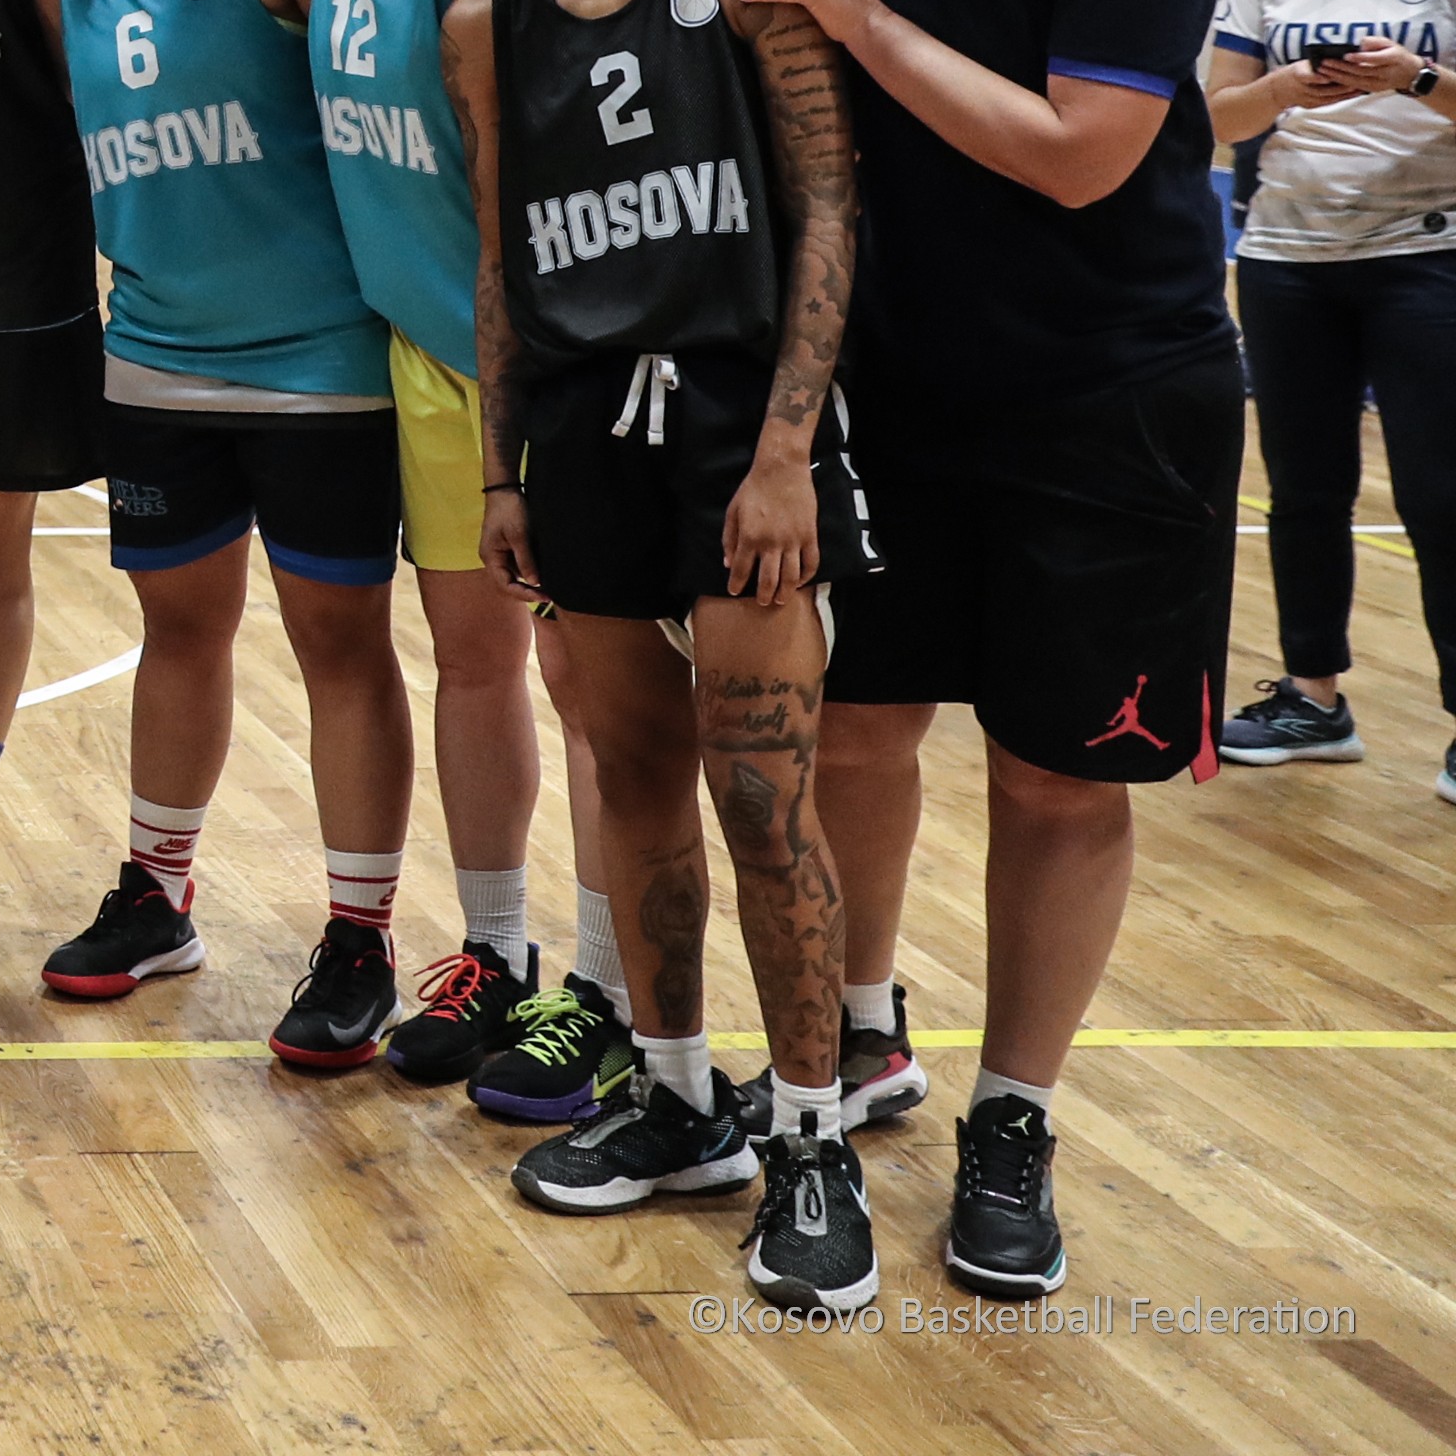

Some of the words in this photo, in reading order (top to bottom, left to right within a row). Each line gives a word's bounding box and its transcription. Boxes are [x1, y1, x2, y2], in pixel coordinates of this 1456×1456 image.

[115, 9, 160, 90] 6
[317, 90, 440, 176] OSOVA
[589, 50, 655, 147] 2
[525, 157, 751, 276] KOSOVA
[164, 837, 194, 851] NIKE
